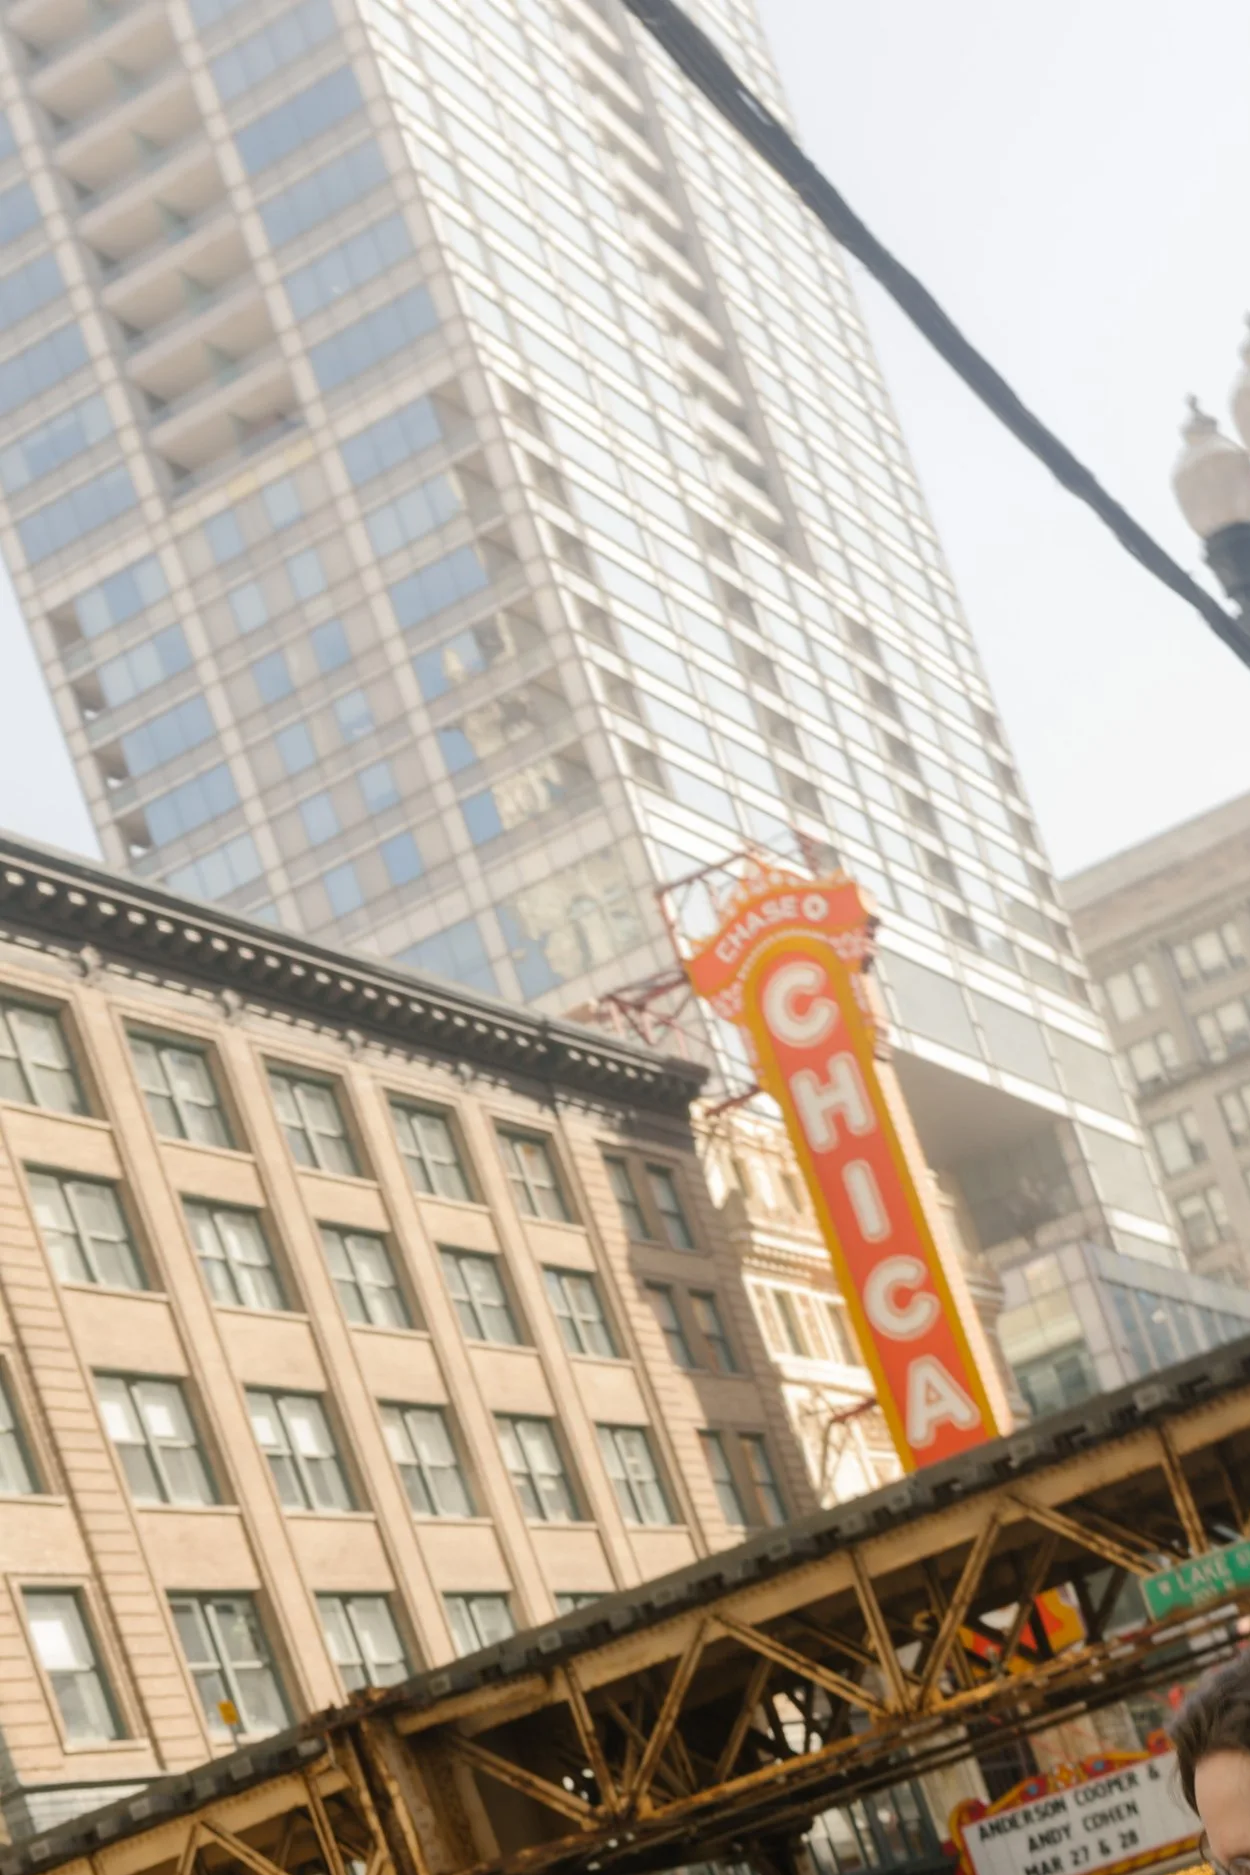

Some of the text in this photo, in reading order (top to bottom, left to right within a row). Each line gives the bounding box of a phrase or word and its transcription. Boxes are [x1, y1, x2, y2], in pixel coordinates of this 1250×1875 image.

[714, 895, 800, 965] CHASE
[1176, 1557, 1232, 1593] LAKE
[977, 1763, 1160, 1842] ANDERSON COOPER &
[1027, 1801, 1139, 1854] ANDY COHEN
[1070, 1846, 1090, 1867] 27
[1098, 1838, 1111, 1857] &
[1118, 1829, 1139, 1850] 28
